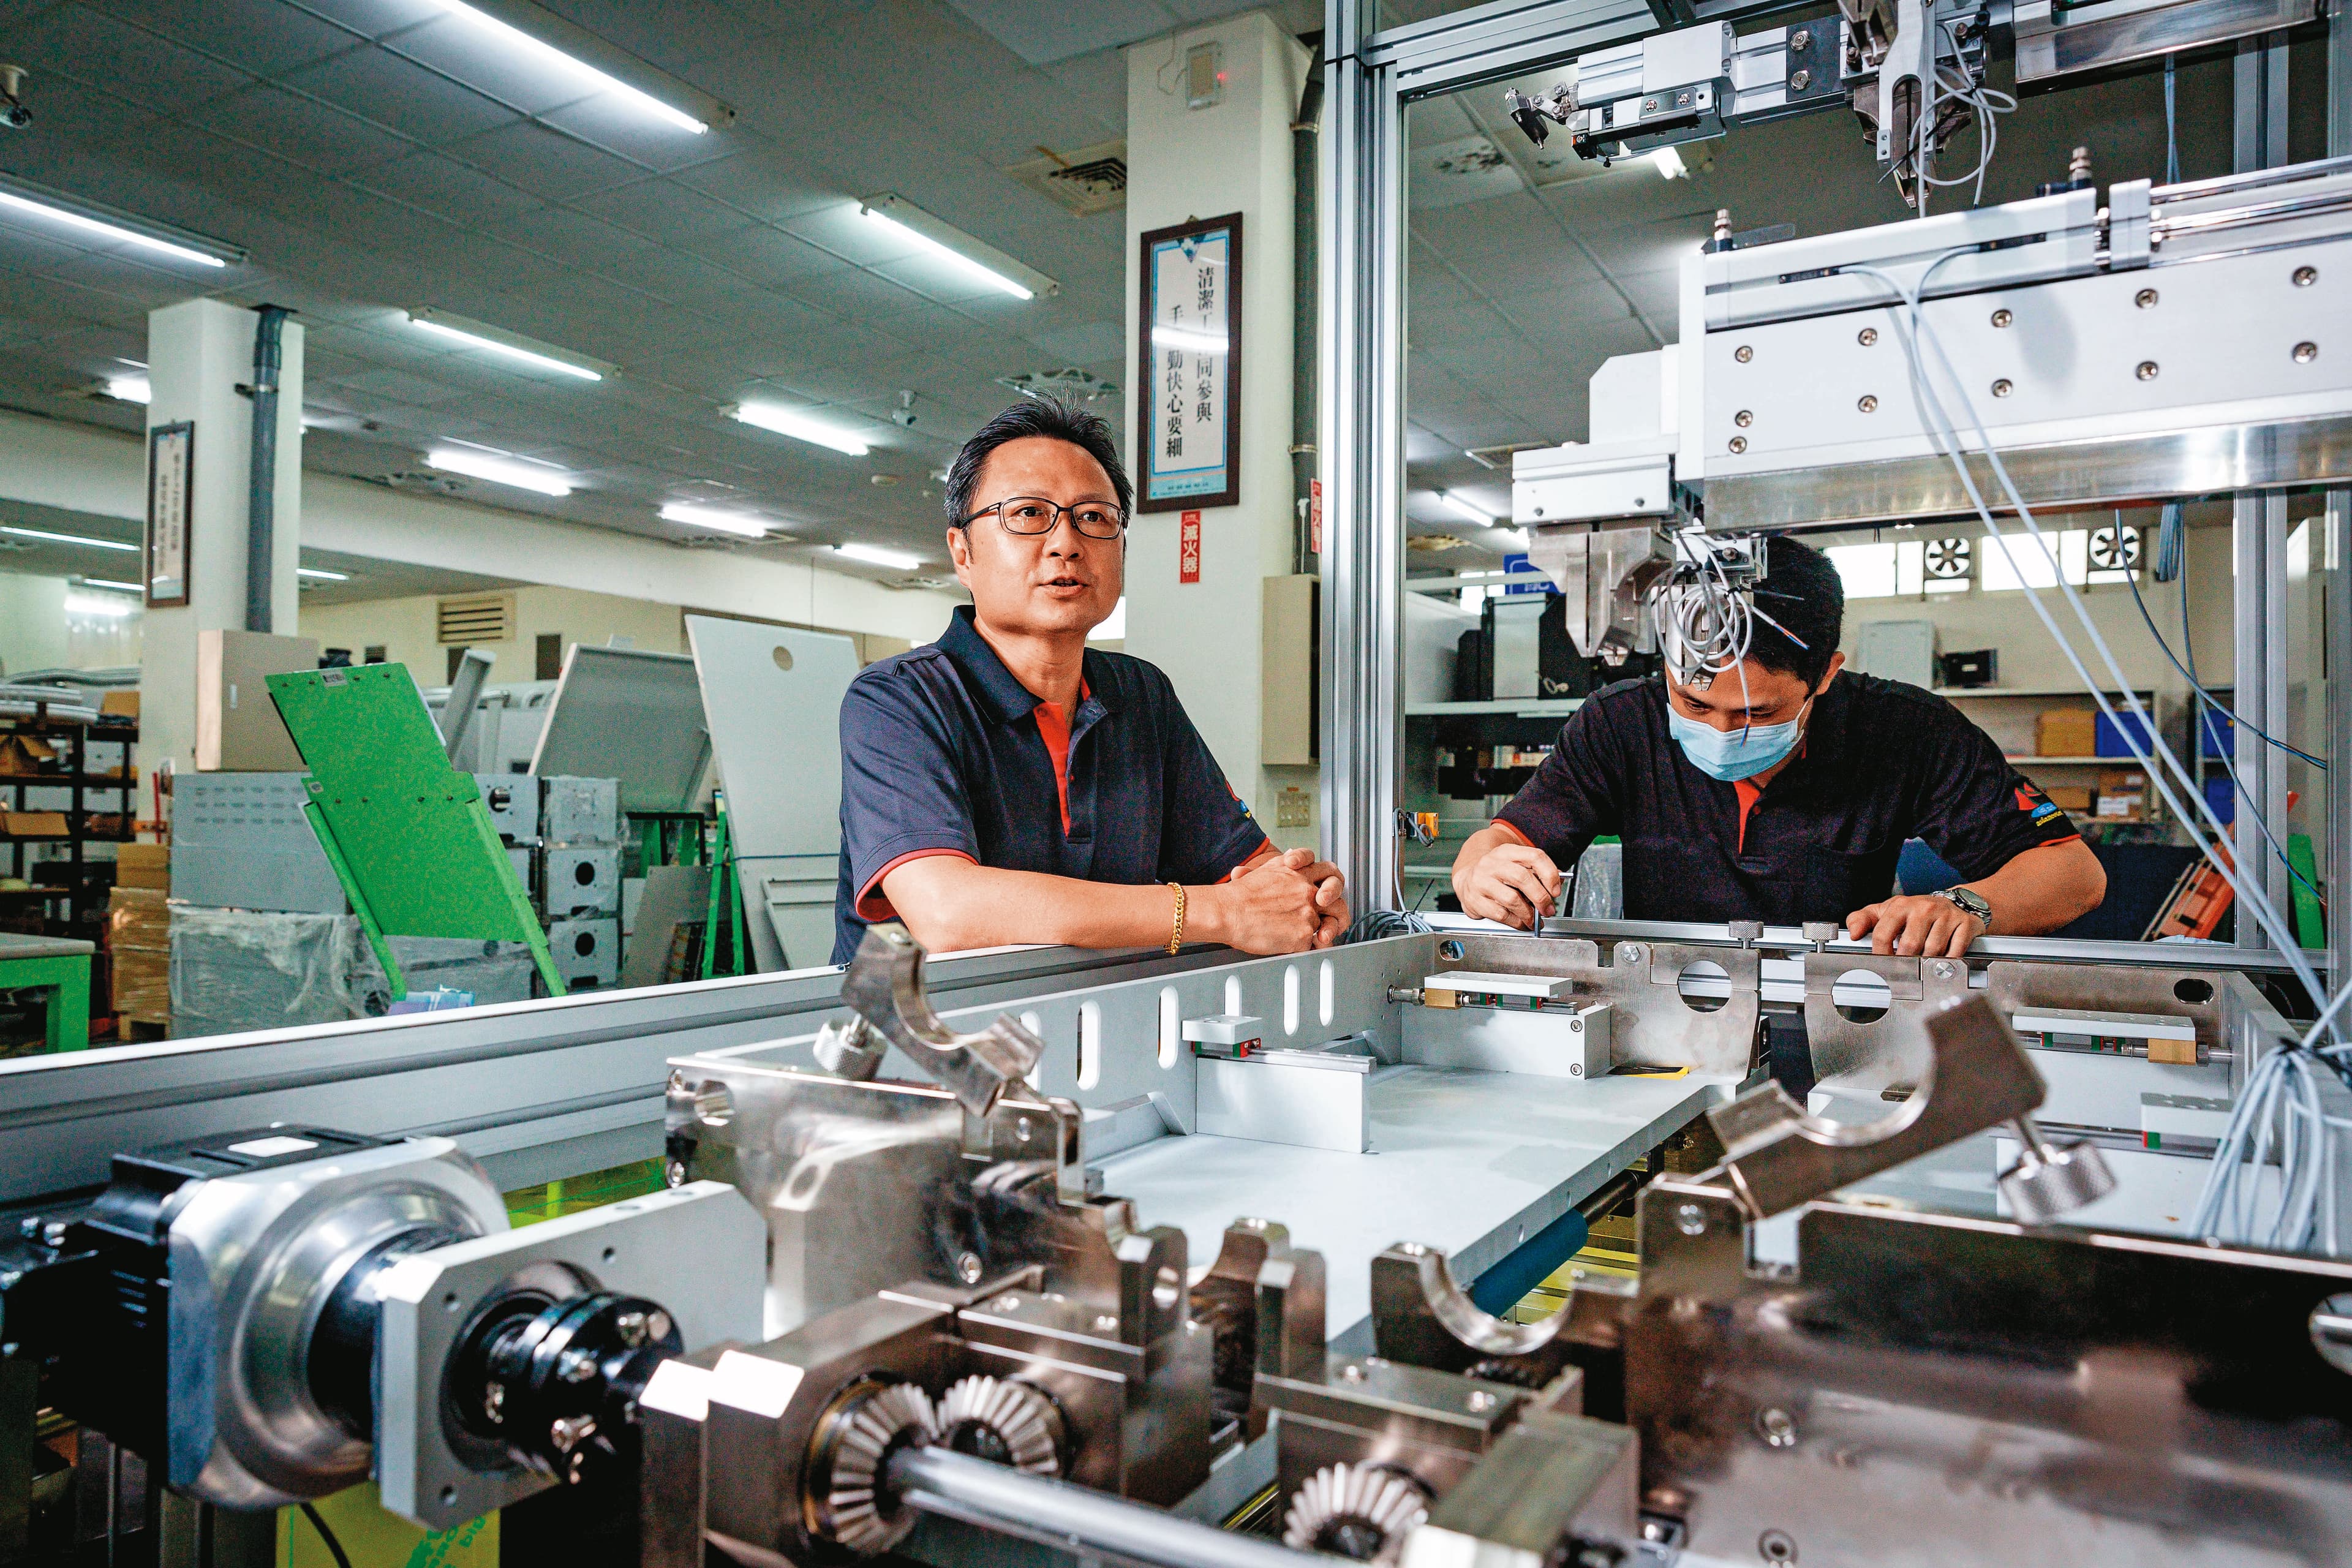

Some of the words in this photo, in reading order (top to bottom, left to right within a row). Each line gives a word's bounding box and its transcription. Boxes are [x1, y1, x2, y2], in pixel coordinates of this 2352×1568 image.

[1166, 304, 1184, 458] 手勤快心要細
[1197, 266, 1214, 423] 清潔工同參與
[1183, 524, 1199, 573] 滅火器
